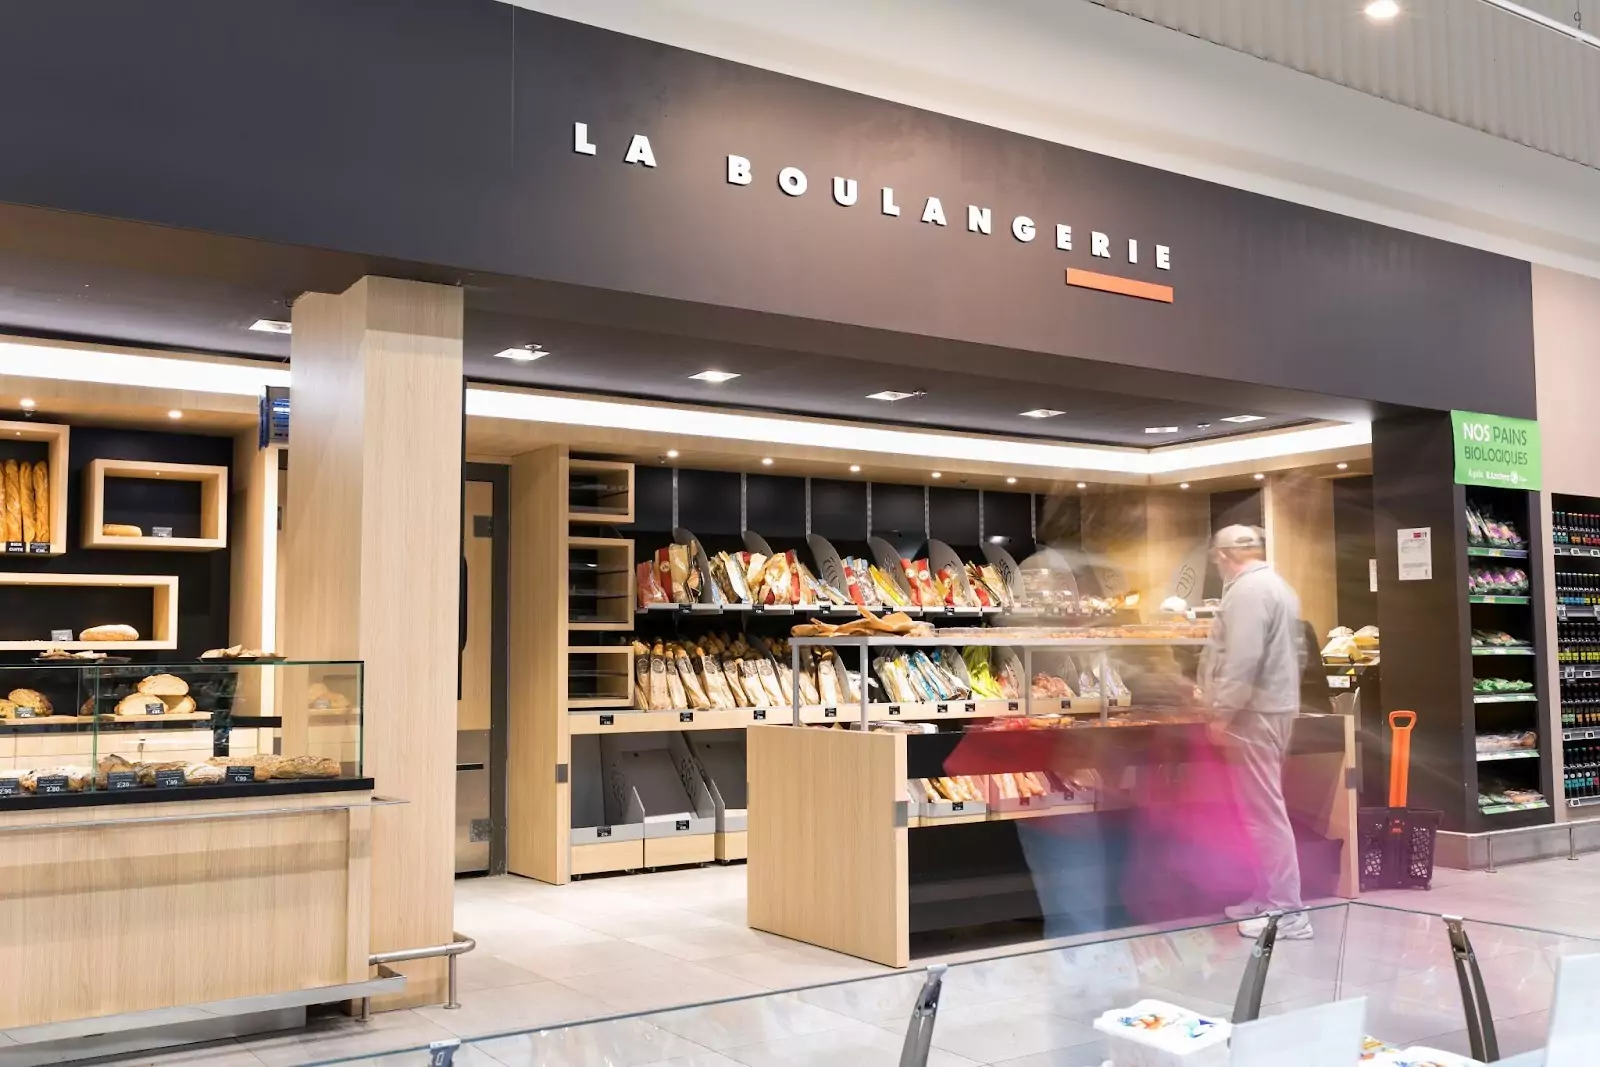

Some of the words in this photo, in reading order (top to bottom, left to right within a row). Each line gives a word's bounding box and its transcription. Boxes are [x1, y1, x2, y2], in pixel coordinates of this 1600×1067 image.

[574, 121, 657, 167] LA
[727, 154, 1172, 270] BOULANGERIE
[1463, 422, 1490, 442] NOS
[1493, 426, 1527, 446] PAINS
[1464, 445, 1528, 466] BIOLOGIQUES
